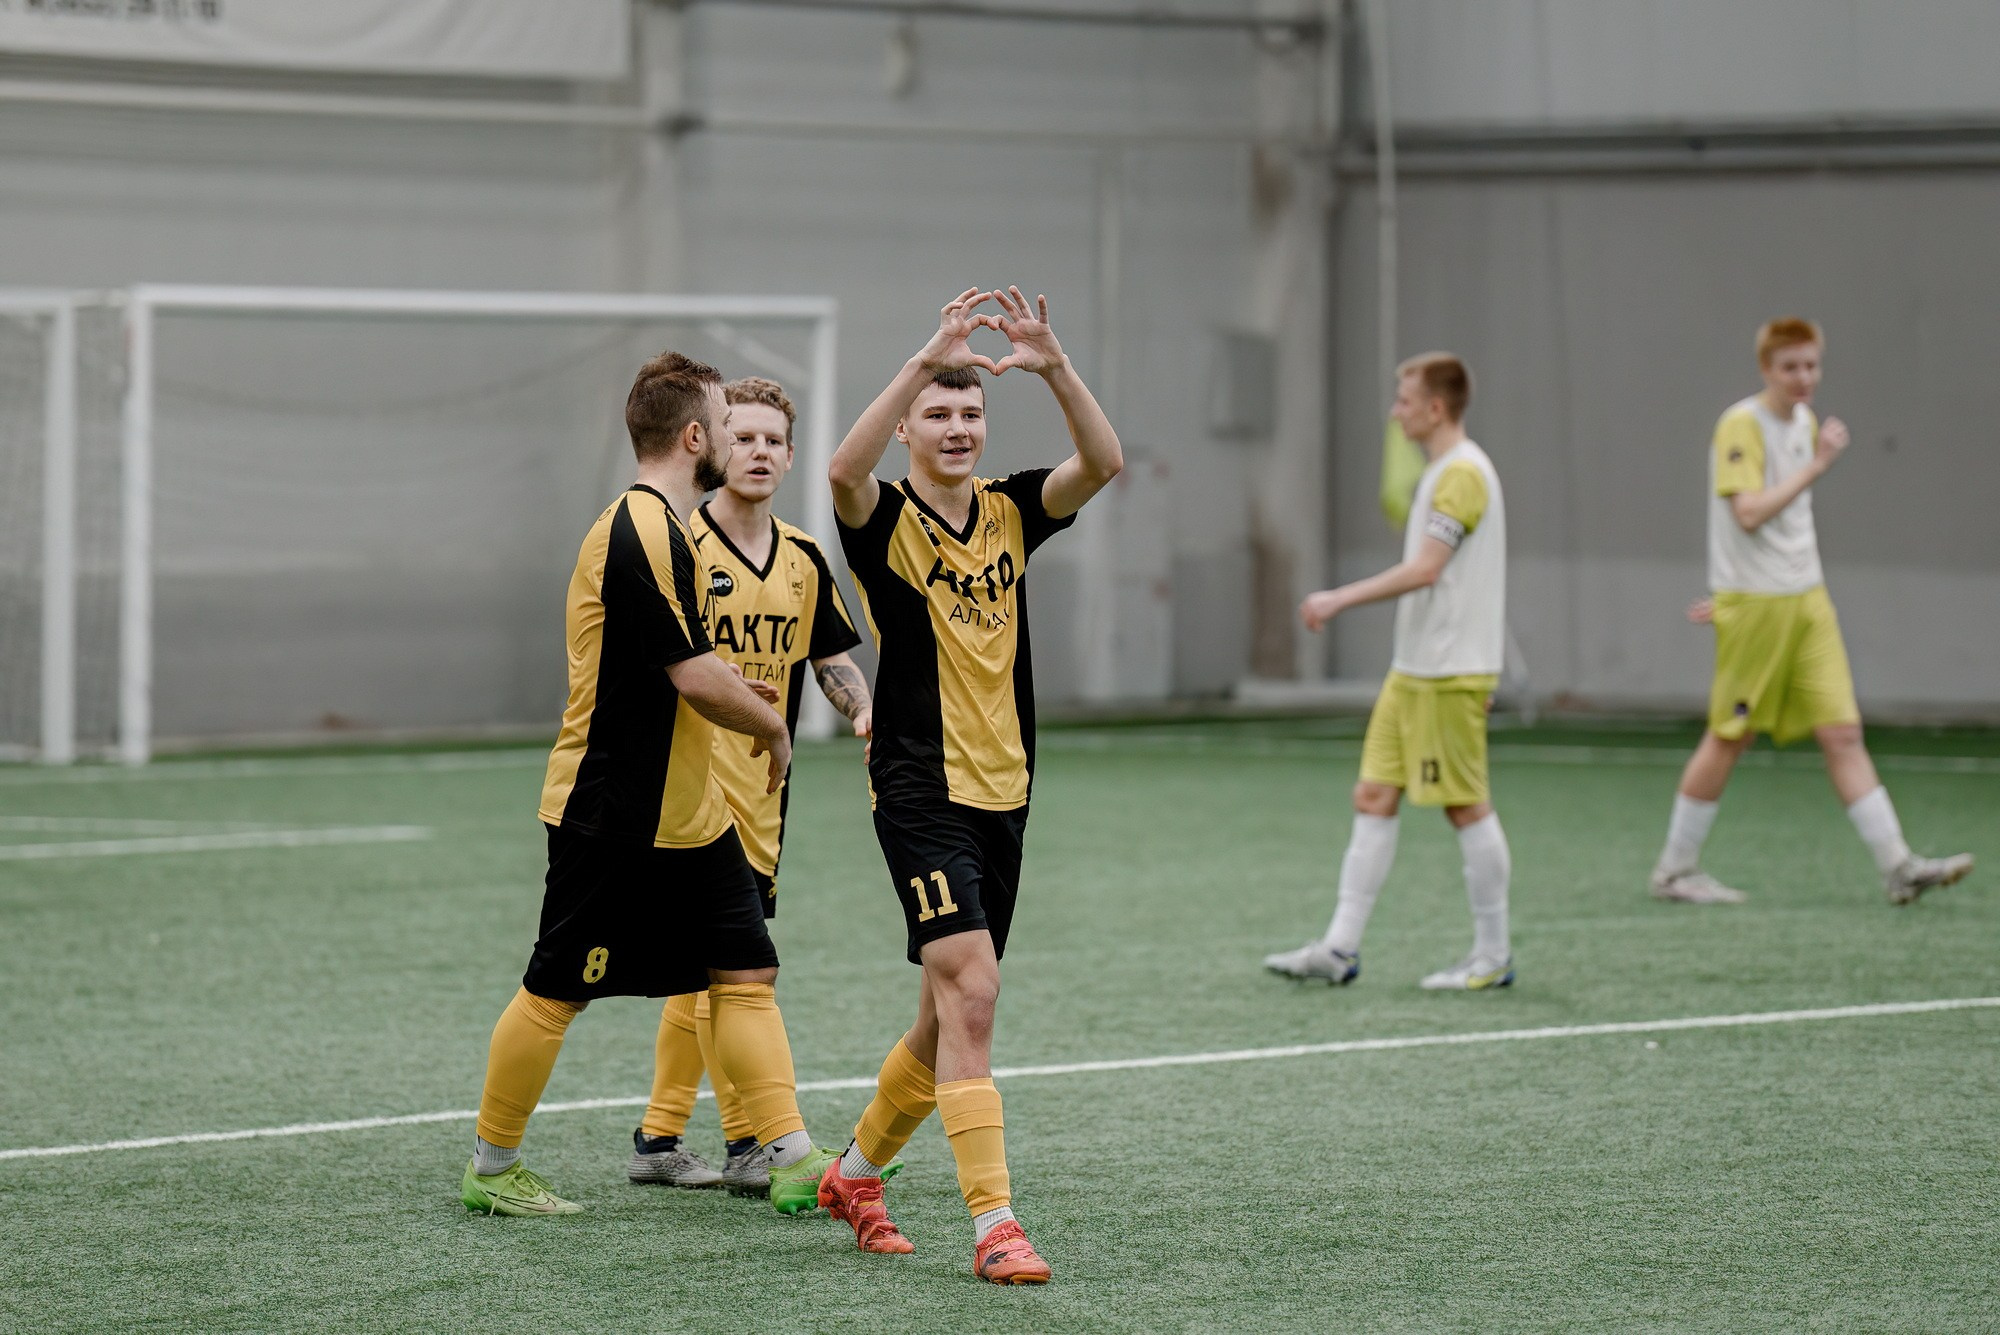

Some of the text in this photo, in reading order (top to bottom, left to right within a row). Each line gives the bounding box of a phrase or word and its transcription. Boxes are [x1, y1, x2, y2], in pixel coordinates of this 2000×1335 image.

[925, 551, 1015, 606] АКТО
[715, 613, 799, 654] АКТО
[910, 870, 959, 922] 11
[582, 946, 610, 984] 8
